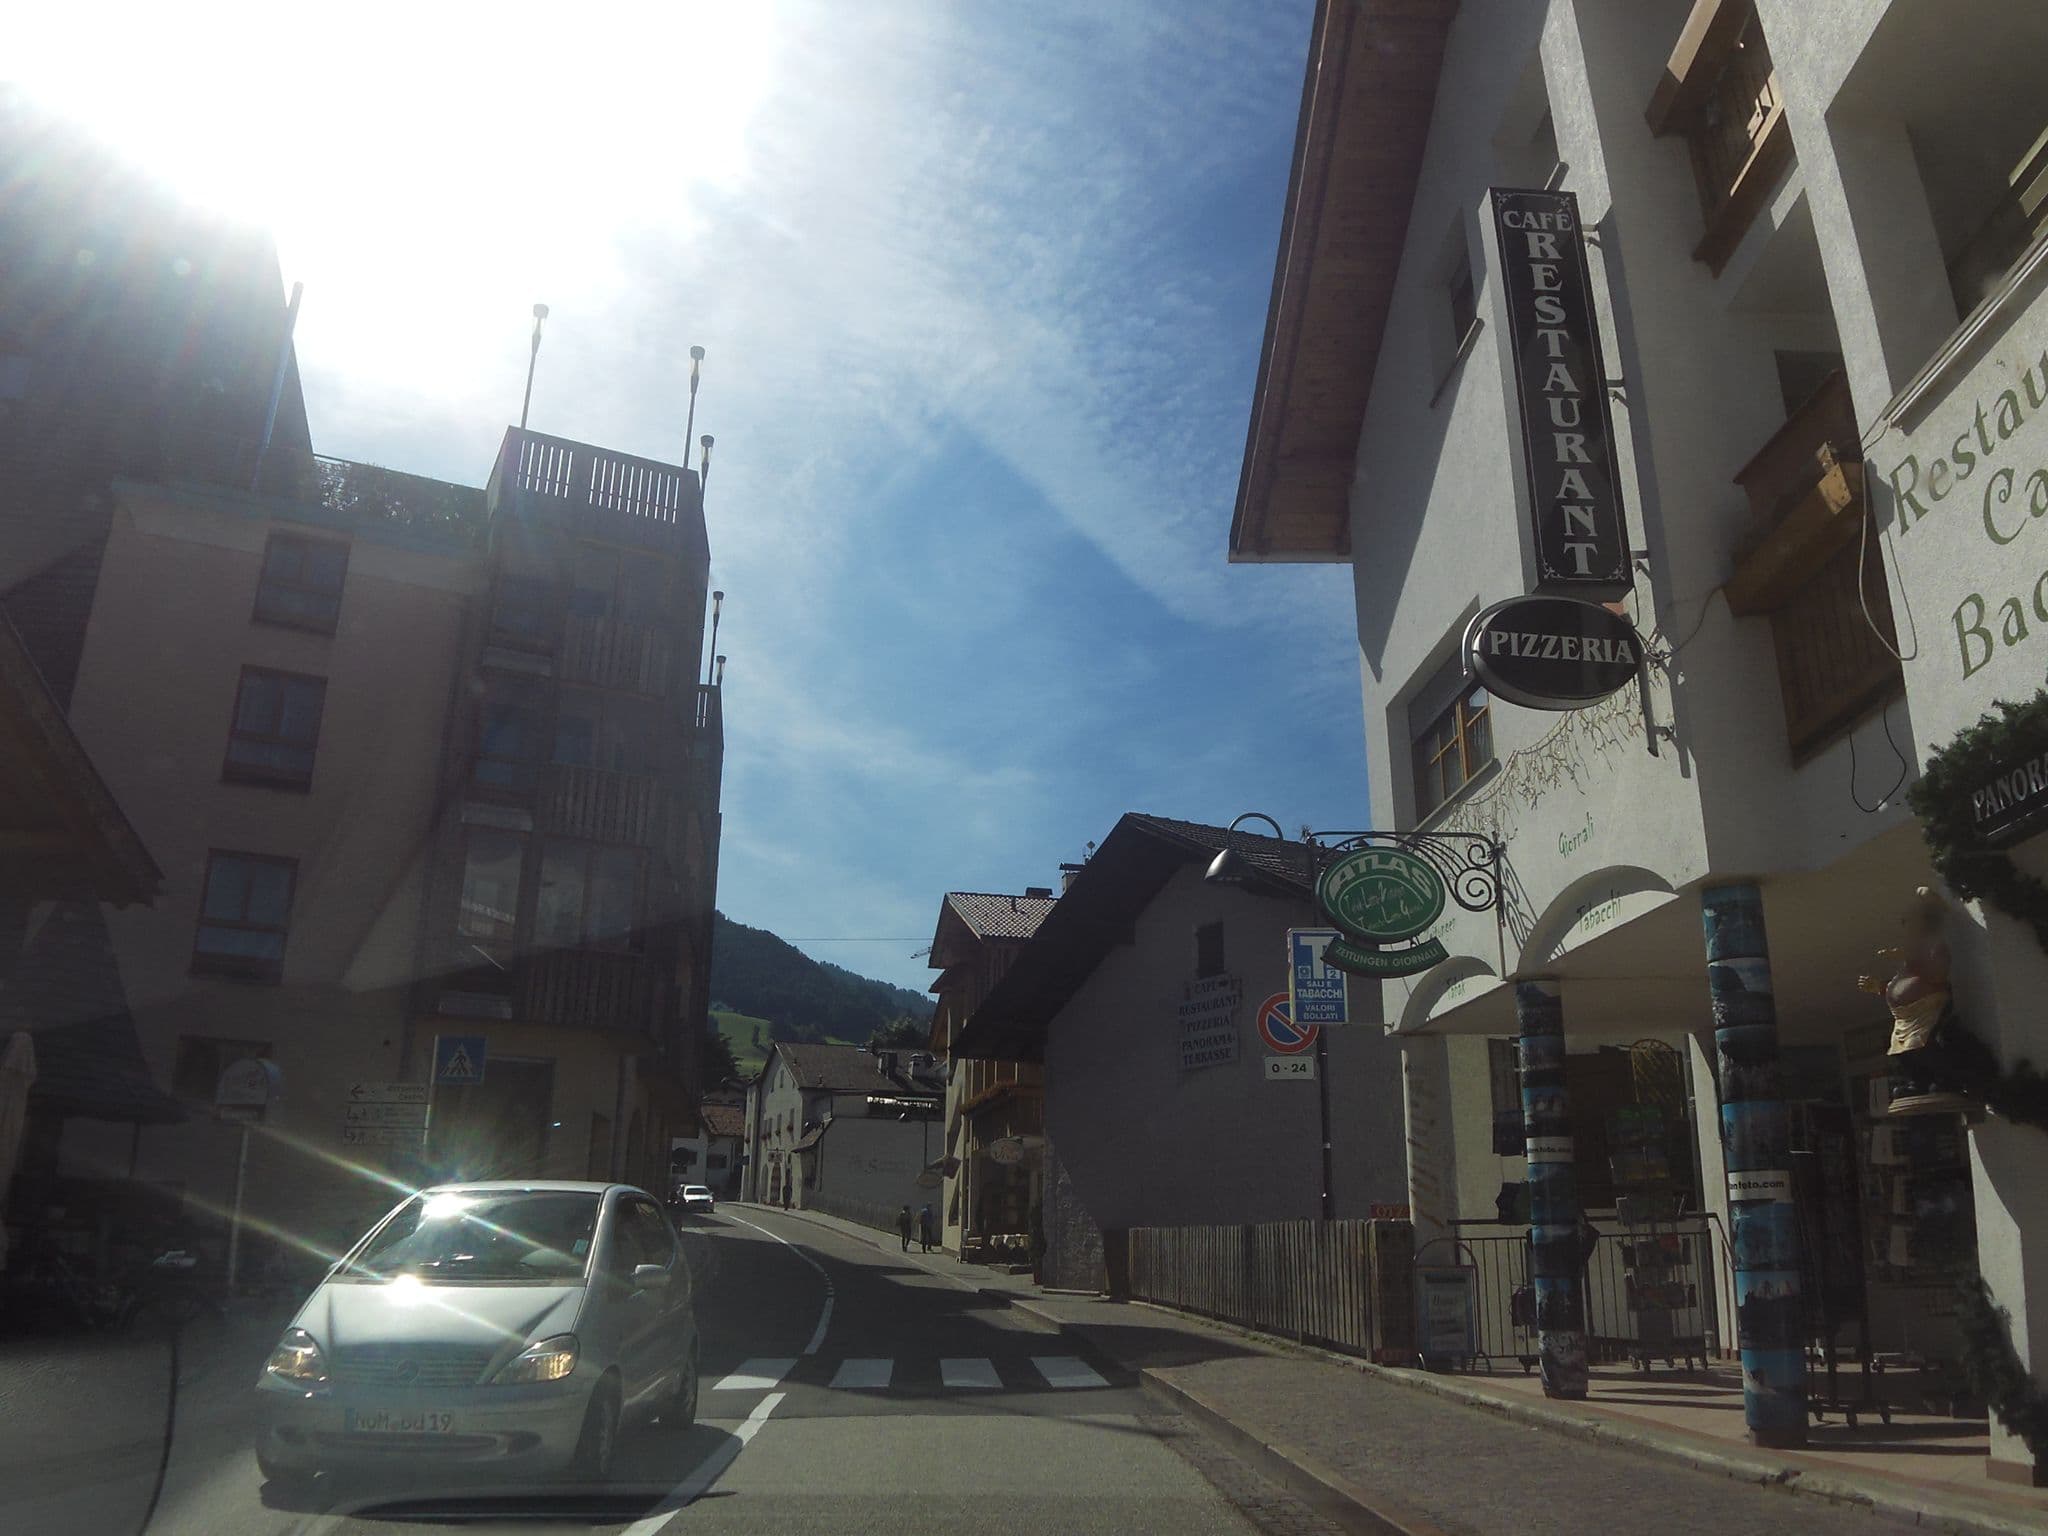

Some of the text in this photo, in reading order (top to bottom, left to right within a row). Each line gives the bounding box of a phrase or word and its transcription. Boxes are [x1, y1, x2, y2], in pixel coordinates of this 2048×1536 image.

[1525, 231, 1598, 575] RESTAURANT
[1889, 349, 2048, 537] Restau
[1489, 630, 1635, 665] PIZZERIA
[1329, 854, 1433, 901] ATLAS
[1576, 888, 1622, 934] Tabacchi
[1336, 946, 1440, 967] ZEITUNGEN GIORNALI
[1297, 989, 1343, 999] TABACCHI
[1303, 1012, 1338, 1020] BOLLATI
[1272, 1063, 1280, 1073] 0
[1291, 1063, 1307, 1073] 24
